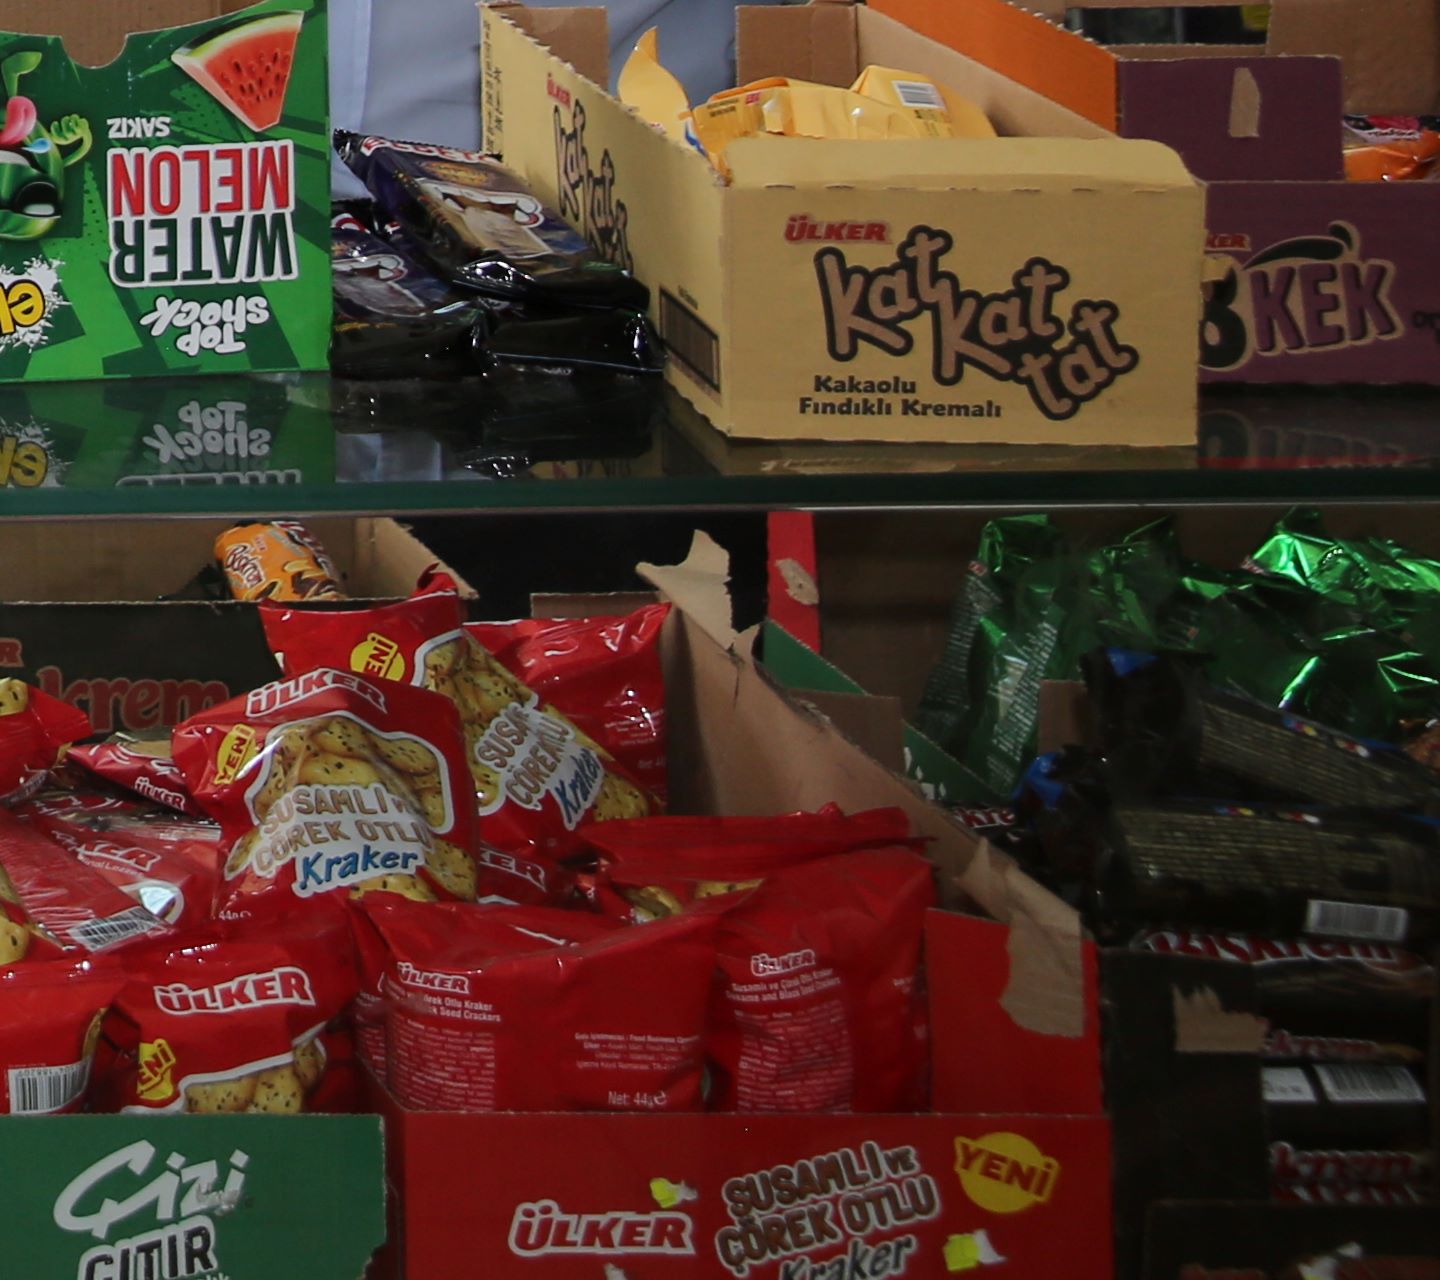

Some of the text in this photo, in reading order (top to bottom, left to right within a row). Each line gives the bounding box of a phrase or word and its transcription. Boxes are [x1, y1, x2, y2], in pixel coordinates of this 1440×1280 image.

[107, 117, 172, 139] SAKIZ
[110, 143, 296, 215] MELON
[109, 213, 298, 284] WATER
[783, 213, 892, 245] ÜLKER
[814, 224, 1141, 421] kat kat tat
[1248, 257, 1408, 358] KEK
[798, 397, 1002, 419] Fındıklı Kremalı
[813, 375, 917, 396] Kakaolu
[245, 667, 389, 720] ÜLKER
[213, 722, 257, 786] YENİ
[134, 775, 186, 811] ÜLKER
[260, 784, 391, 838] SUSAMLI
[296, 843, 423, 893] Kraker
[396, 961, 473, 995] ÜLKER
[750, 948, 817, 978] ÜLKER
[153, 965, 317, 1016] ÜLKER
[462, 1009, 502, 1023] Crackers
[464, 998, 494, 1013] Kraker
[52, 1139, 251, 1240] Çizi
[721, 1140, 920, 1220] SUSAMLI VE
[953, 1134, 1061, 1205] YENİ
[507, 1197, 696, 1257] ÜLKER
[714, 1174, 941, 1276] ÇÖREK OTLU
